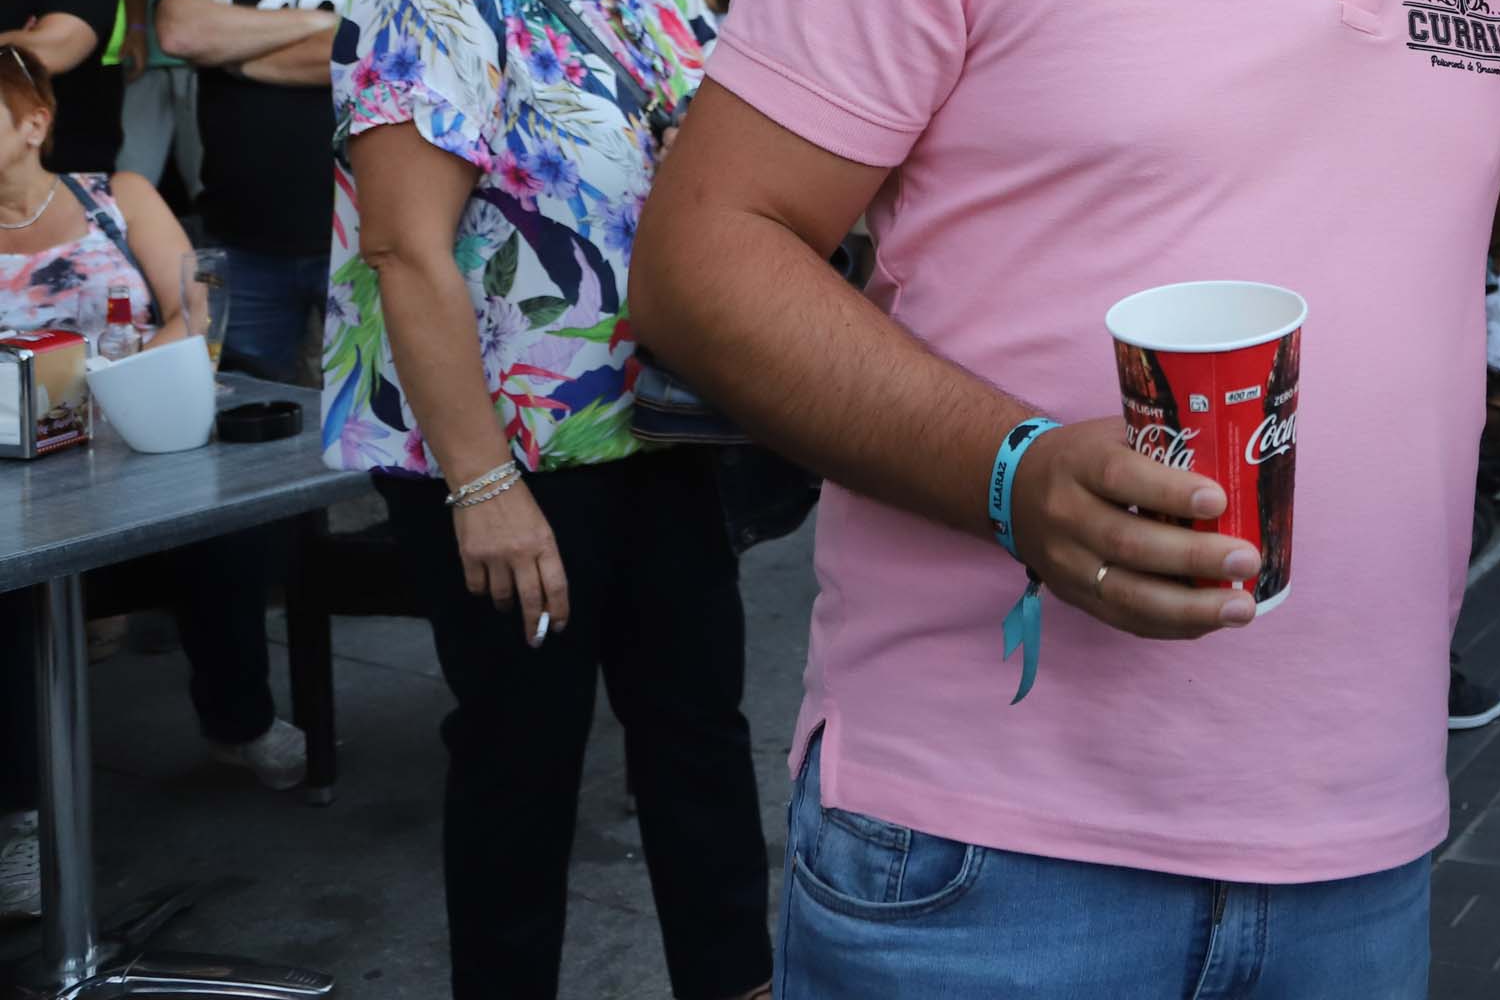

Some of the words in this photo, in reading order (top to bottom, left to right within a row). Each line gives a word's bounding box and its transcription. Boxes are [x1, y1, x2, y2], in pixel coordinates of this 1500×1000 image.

[1227, 391, 1245, 402] 400
[1246, 387, 1258, 399] ml
[1274, 387, 1294, 407] ZERO
[1136, 403, 1164, 419] LIGHT
